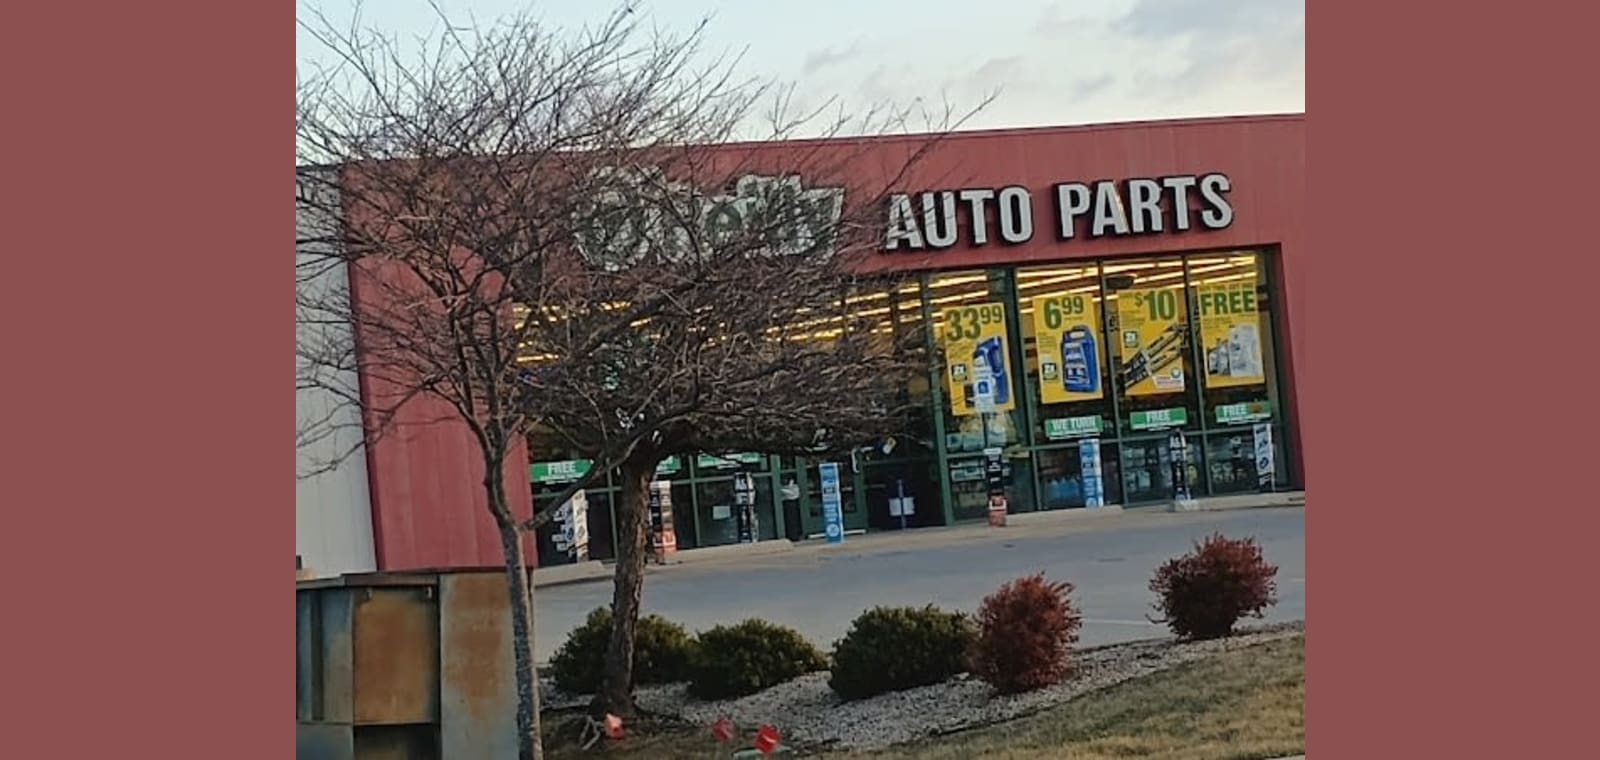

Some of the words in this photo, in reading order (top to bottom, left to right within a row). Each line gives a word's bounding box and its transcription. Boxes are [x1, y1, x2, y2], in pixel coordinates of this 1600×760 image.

[886, 185, 1034, 250] AUTO
[1057, 173, 1234, 240] PARTS
[1134, 289, 1176, 321] $10
[1200, 290, 1256, 315] FREE
[1145, 410, 1171, 424] FREE
[1223, 406, 1249, 419] FREE
[548, 460, 576, 474] FREE
